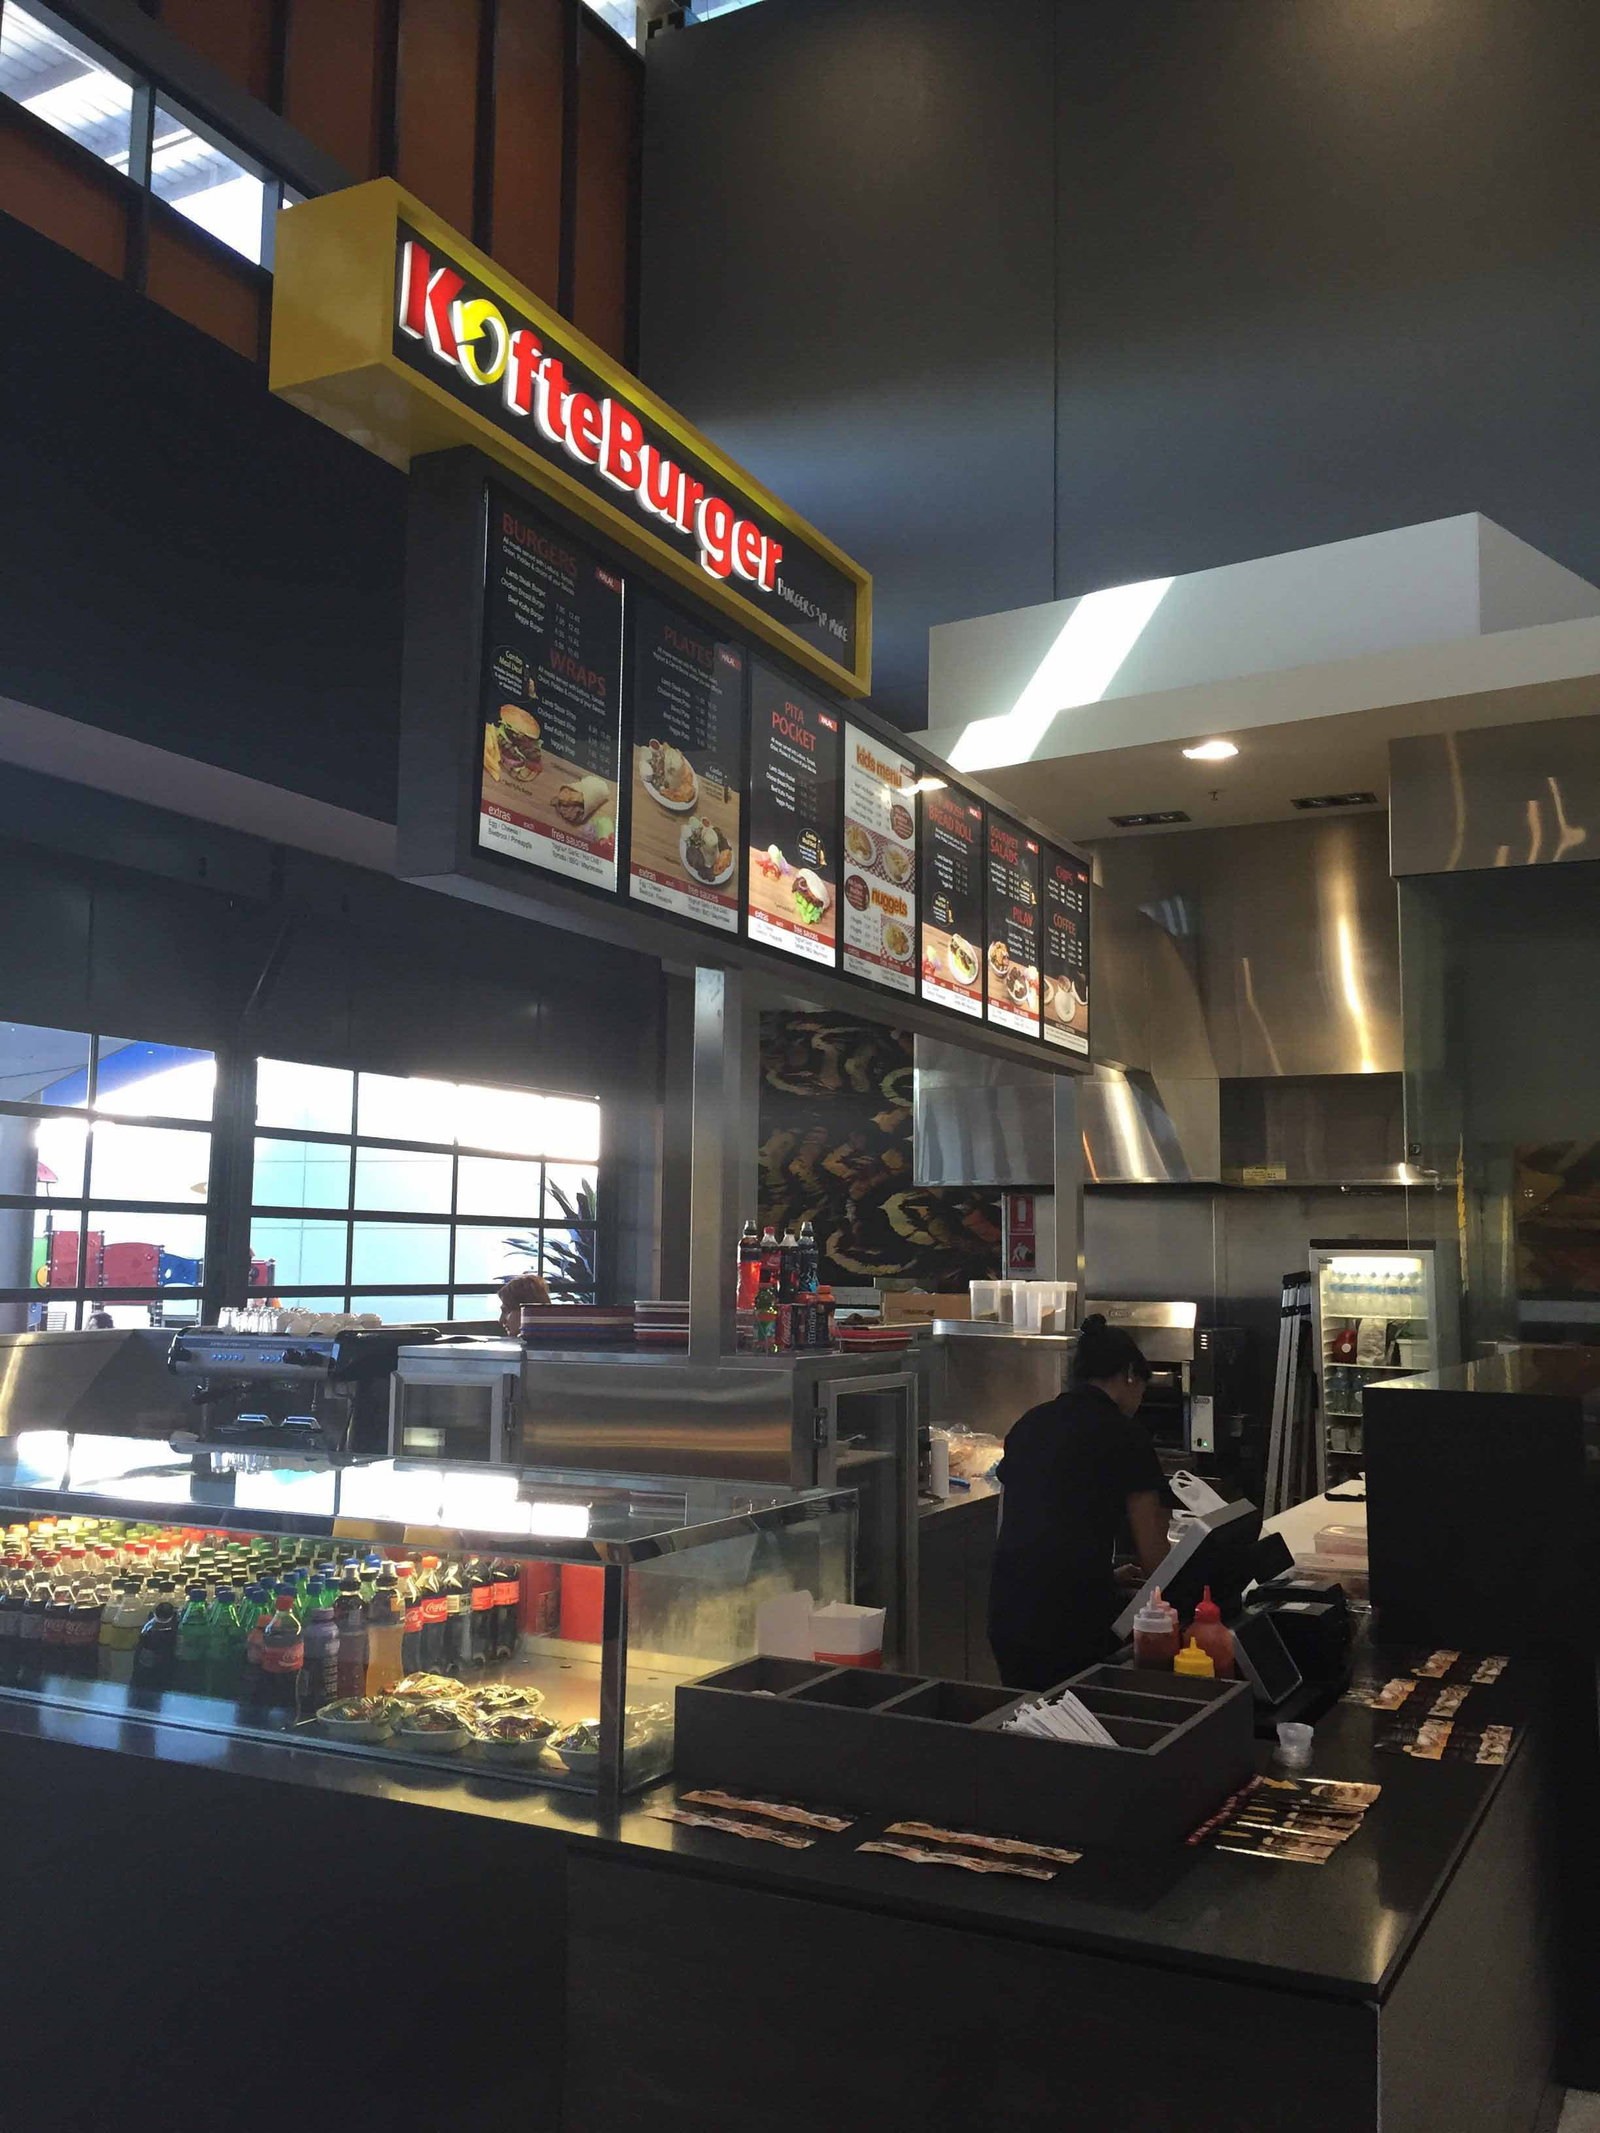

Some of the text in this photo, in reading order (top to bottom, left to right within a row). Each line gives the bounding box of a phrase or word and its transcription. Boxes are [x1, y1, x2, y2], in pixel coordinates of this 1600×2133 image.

[502, 512, 577, 577] BURGERS
[550, 648, 606, 697] WRAPS
[771, 711, 817, 752] POCKET
[785, 701, 804, 725] PITA
[856, 744, 876, 772] kids
[876, 762, 903, 788] menu
[489, 806, 511, 822] extras
[552, 828, 565, 842] free
[566, 835, 589, 851] sauces
[928, 804, 954, 831] BREAD
[953, 819, 974, 843] ROLL
[990, 839, 1019, 866] SALADS
[871, 887, 908, 918] nuggets
[1053, 912, 1077, 936] COFFEE
